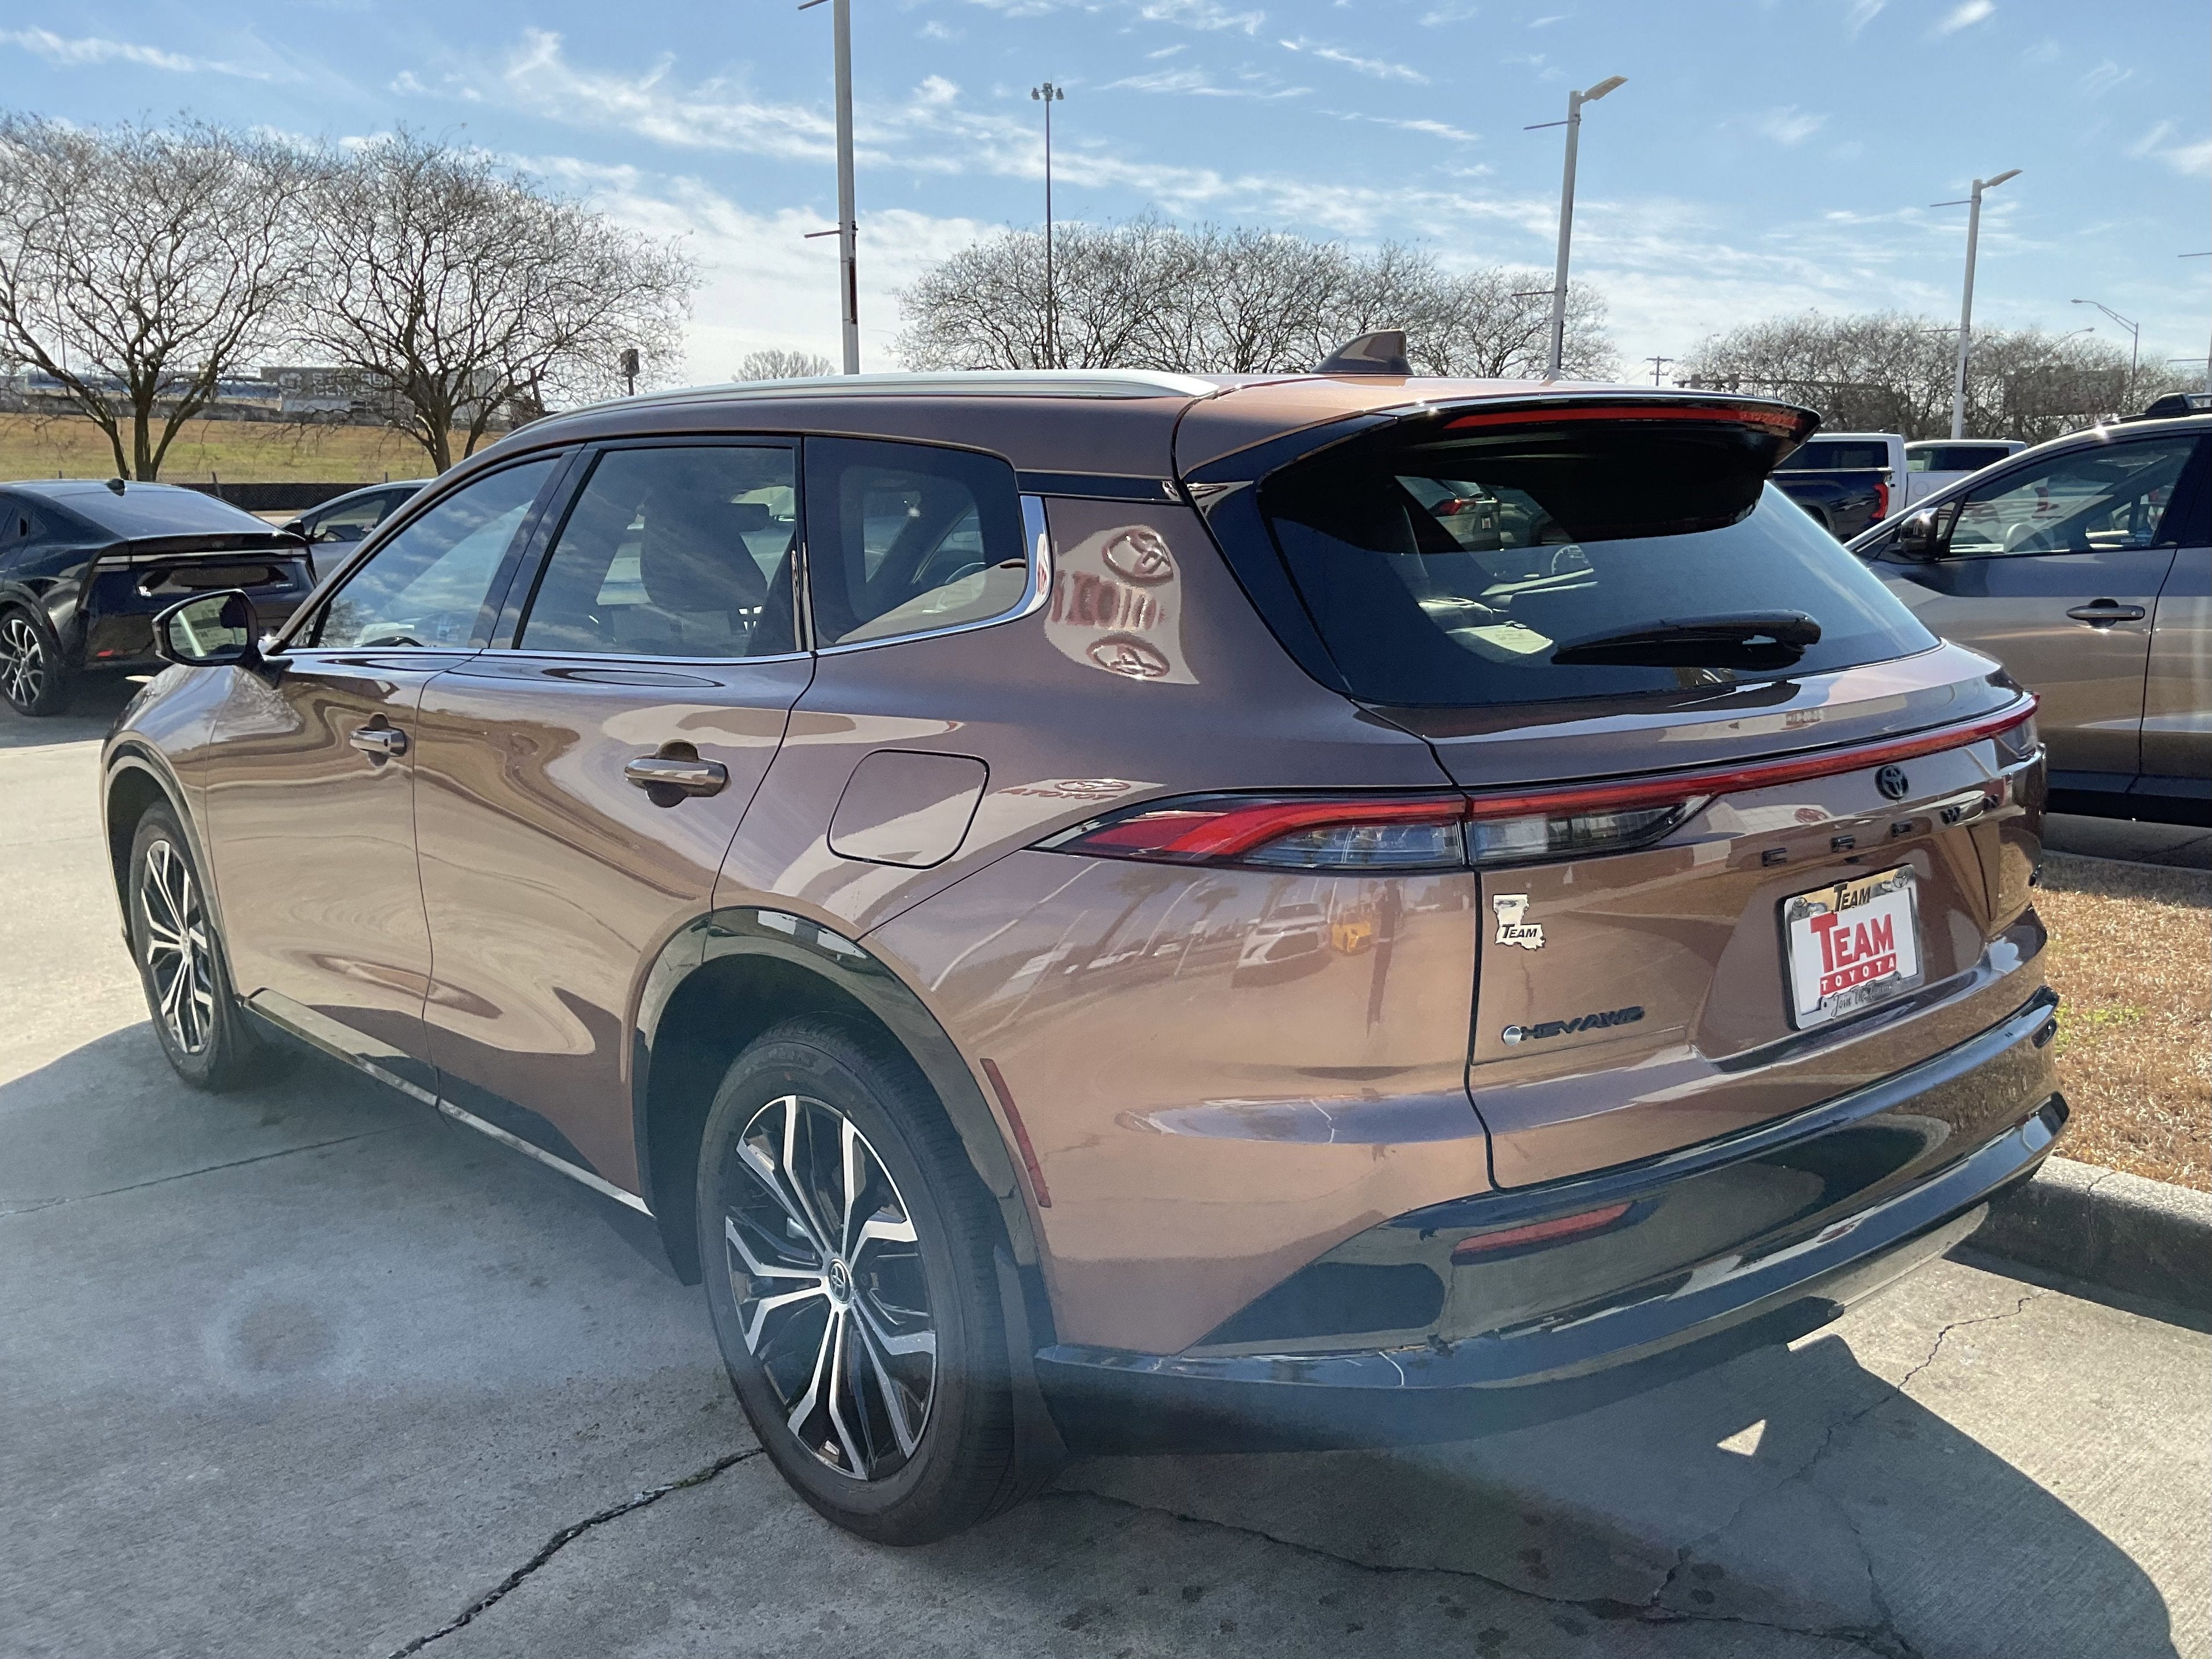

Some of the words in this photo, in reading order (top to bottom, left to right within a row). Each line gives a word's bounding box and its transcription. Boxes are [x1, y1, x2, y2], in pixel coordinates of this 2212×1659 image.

[1834, 882, 1871, 913] TEAM
[1502, 923, 1537, 939] TEAM
[1810, 912, 1895, 974] TEAM
[1821, 957, 1895, 991] TOYOTA
